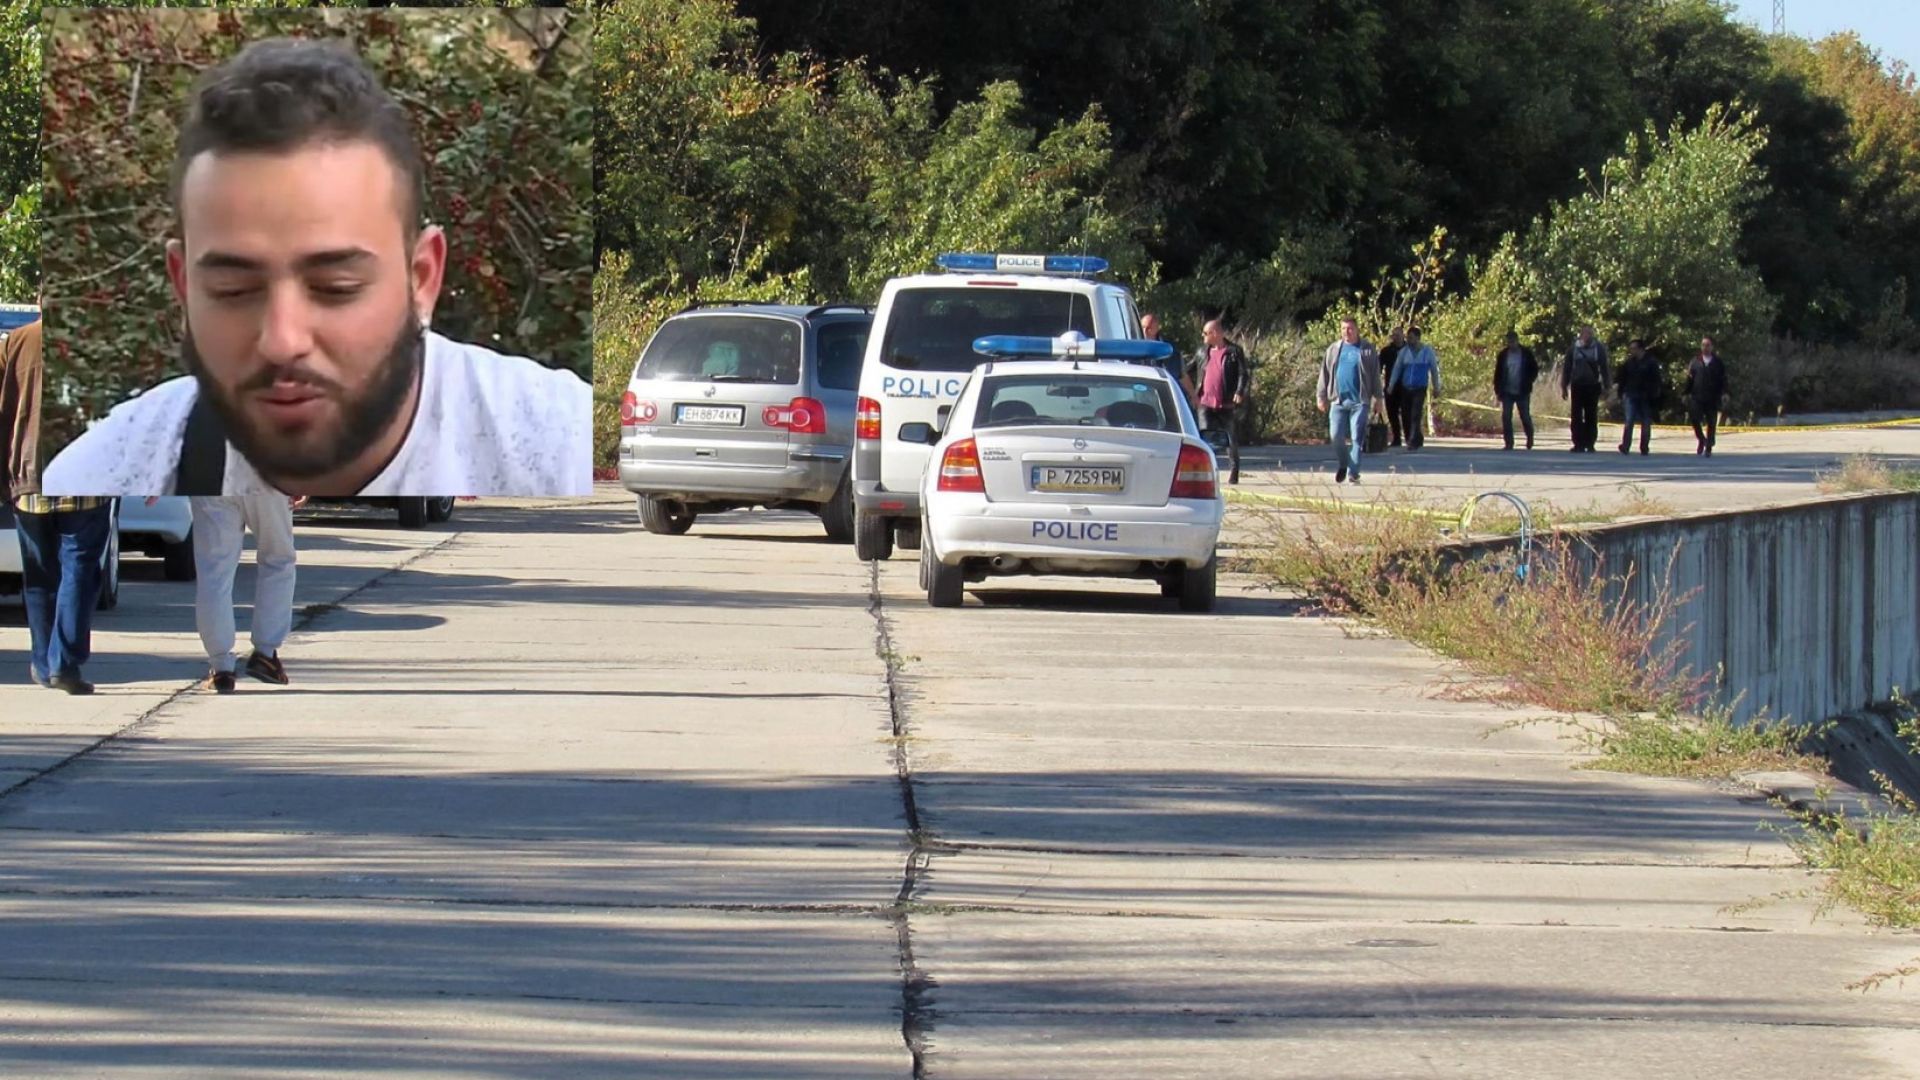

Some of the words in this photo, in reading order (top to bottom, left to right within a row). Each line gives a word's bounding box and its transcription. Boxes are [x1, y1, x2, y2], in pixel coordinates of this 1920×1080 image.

[999, 256, 1041, 266] POLICE
[883, 376, 960, 396] POLIC
[1032, 521, 1119, 541] POLICE
